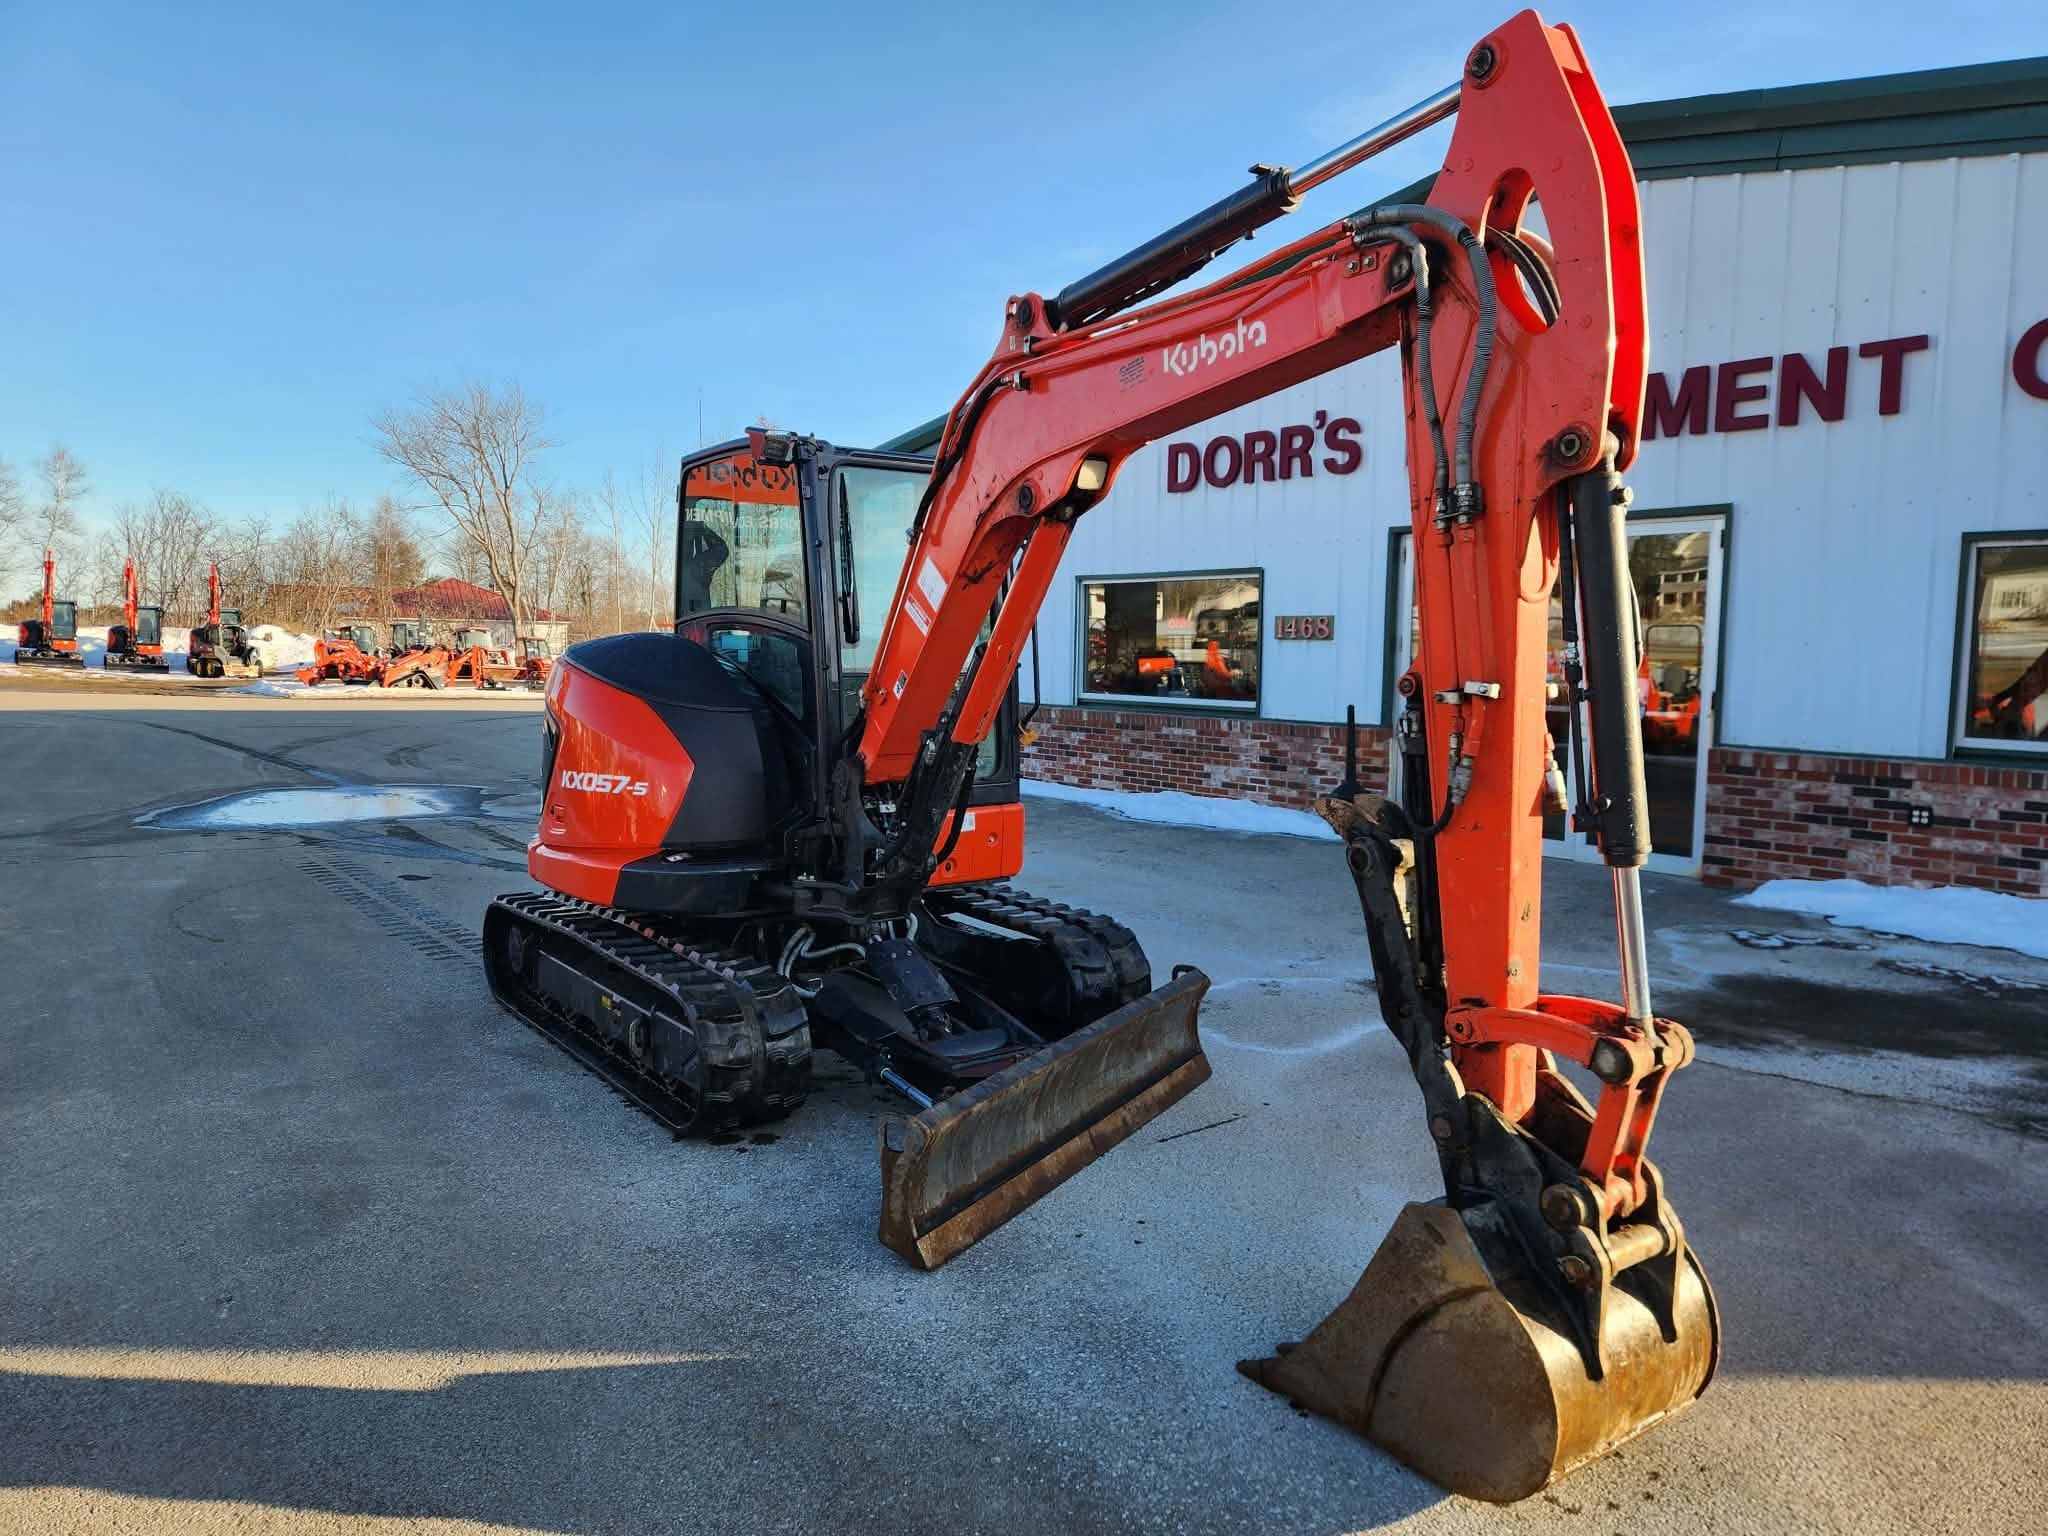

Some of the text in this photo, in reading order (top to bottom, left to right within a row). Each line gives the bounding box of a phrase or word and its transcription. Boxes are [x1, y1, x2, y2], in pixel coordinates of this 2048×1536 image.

[1162, 317, 1267, 377] Kubota
[1167, 409, 1363, 494] DORR'S
[1276, 616, 1331, 639] 1468
[561, 770, 649, 797] KX057-5
